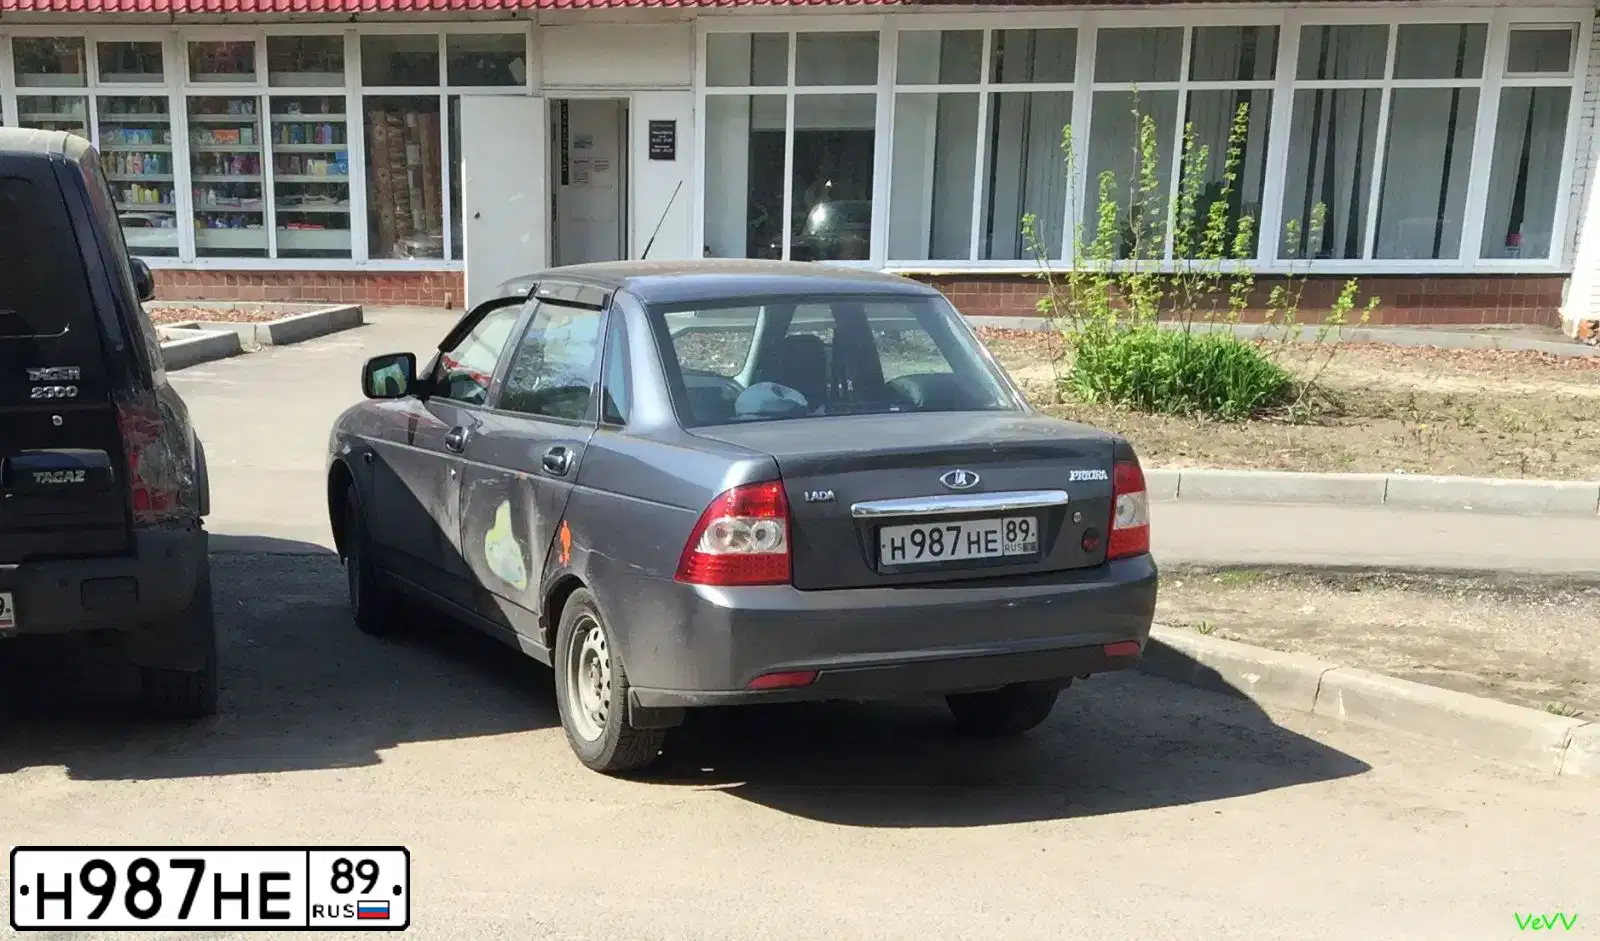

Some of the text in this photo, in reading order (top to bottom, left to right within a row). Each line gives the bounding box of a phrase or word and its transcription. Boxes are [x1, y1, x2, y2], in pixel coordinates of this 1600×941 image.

[30, 385, 78, 399] 2300
[33, 470, 86, 484] TAGAZ
[1068, 469, 1108, 481] PRIORA
[803, 489, 836, 502] LADA
[1006, 519, 1030, 543] 89
[1004, 543, 1023, 552] RUS
